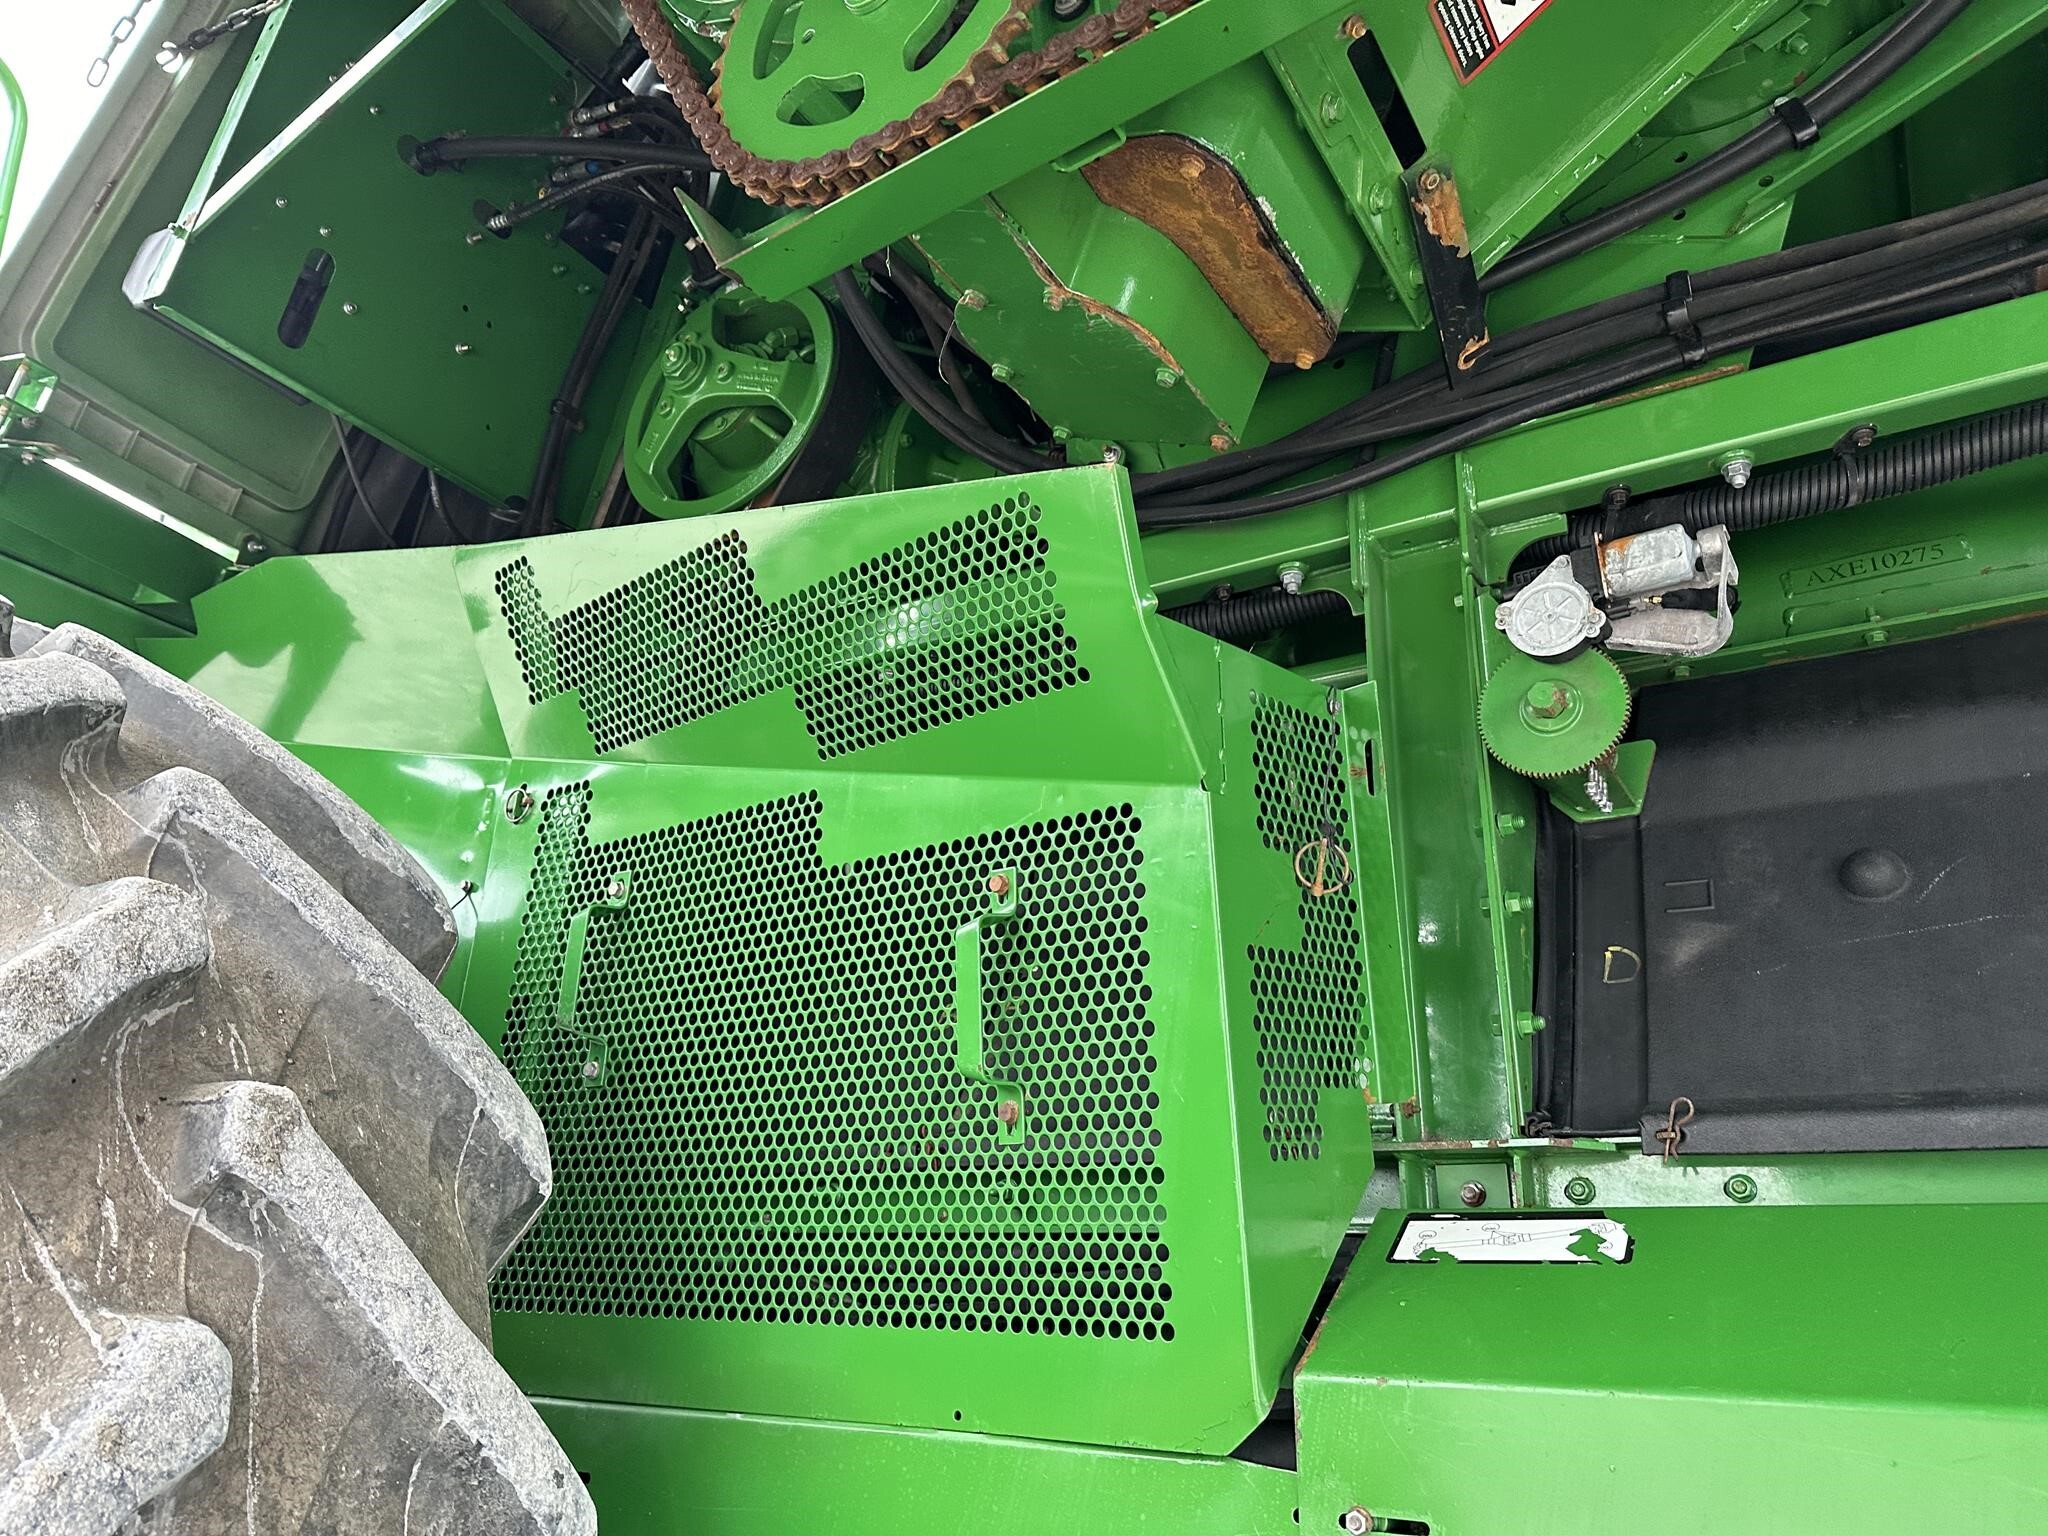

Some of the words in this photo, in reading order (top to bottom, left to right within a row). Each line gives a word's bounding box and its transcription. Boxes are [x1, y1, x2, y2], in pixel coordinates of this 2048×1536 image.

[1438, 2, 1451, 28] opening
[1450, 6, 1462, 29] remove
[1463, 37, 1474, 57] before
[1468, 25, 1477, 41] Stop
[1474, 40, 1485, 60] engine
[1476, 17, 1485, 37] injury
[1482, 33, 1490, 50] from
[1807, 543, 1945, 586] AXE10275
